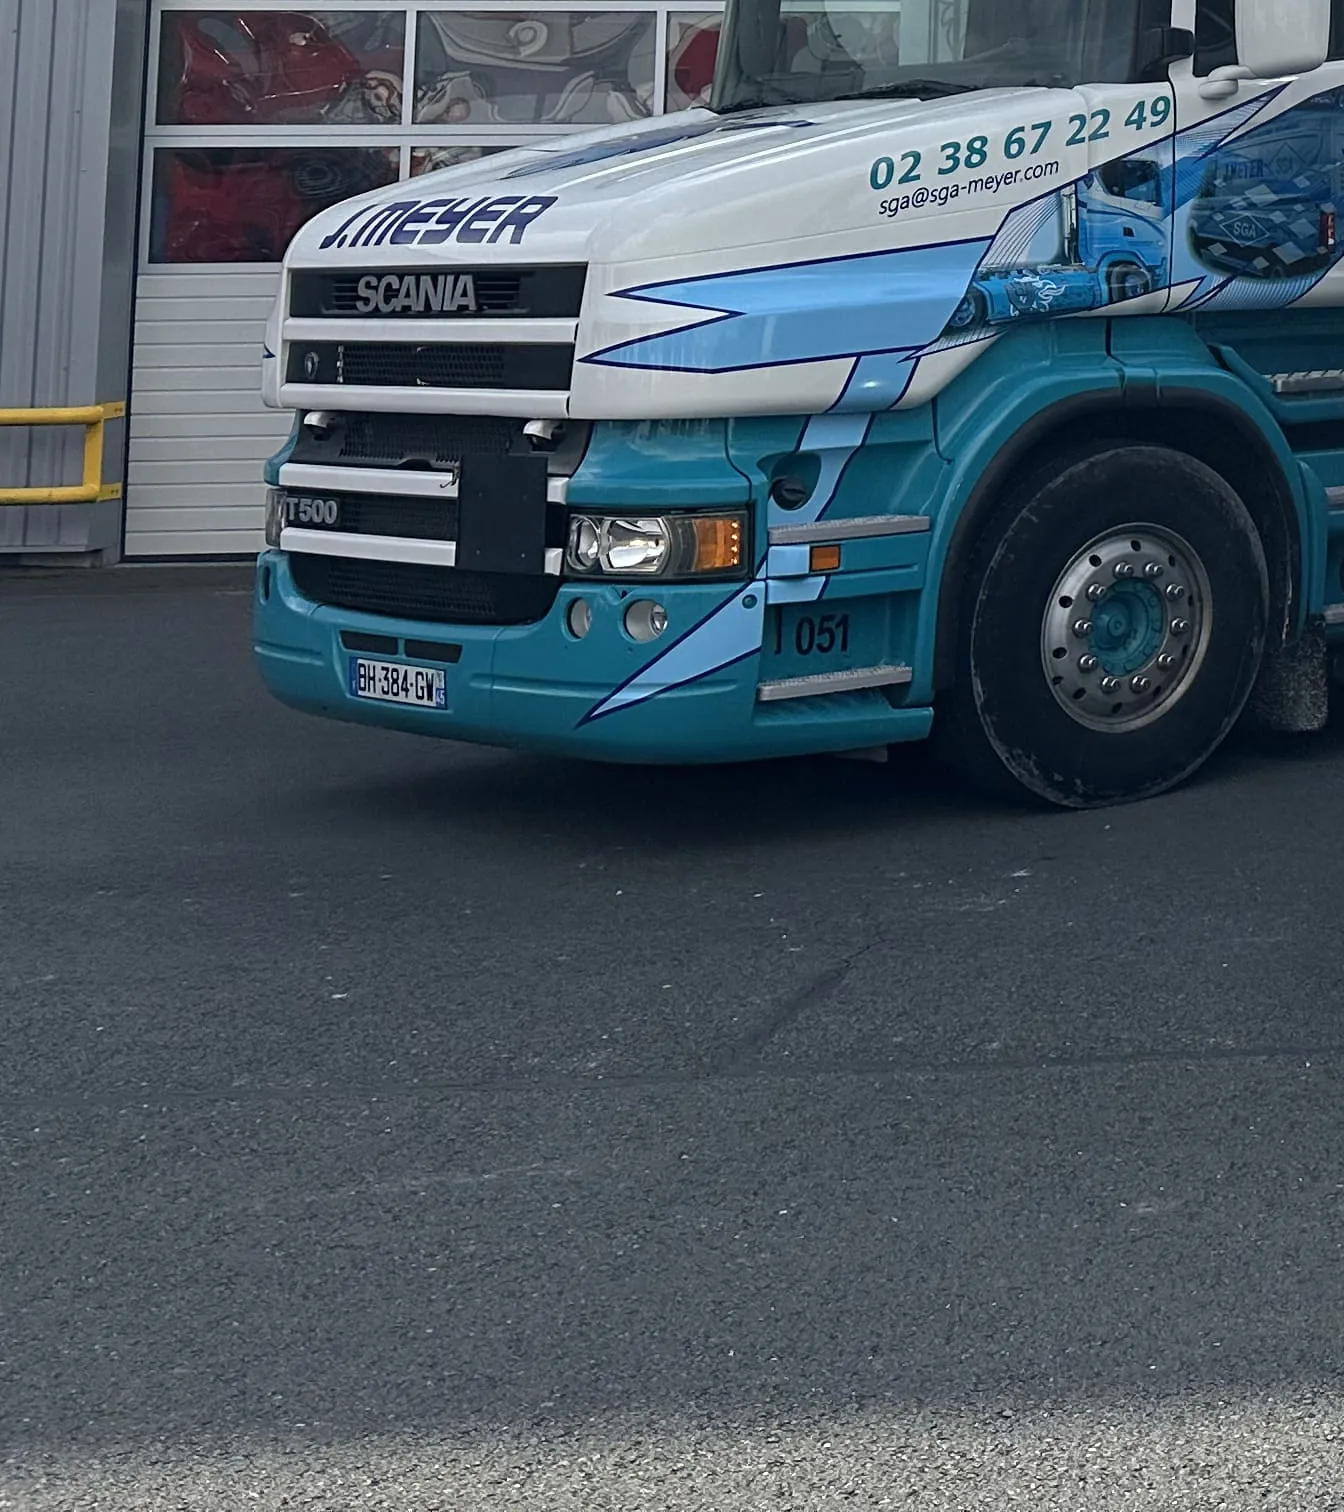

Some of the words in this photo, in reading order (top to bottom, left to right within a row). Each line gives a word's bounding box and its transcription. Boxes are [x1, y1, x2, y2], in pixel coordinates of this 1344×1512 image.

[869, 150, 921, 190] 02
[937, 135, 989, 176] 38
[1003, 120, 1052, 160] 67
[1065, 108, 1111, 147] 22
[1124, 95, 1171, 131] 49
[878, 159, 1060, 218] sga@sga-meyer.com
[319, 196, 559, 250] J.MEYER
[1233, 214, 1257, 237] SGA
[355, 274, 477, 313] SCANIA
[288, 497, 338, 524] T500
[796, 614, 849, 656] 051
